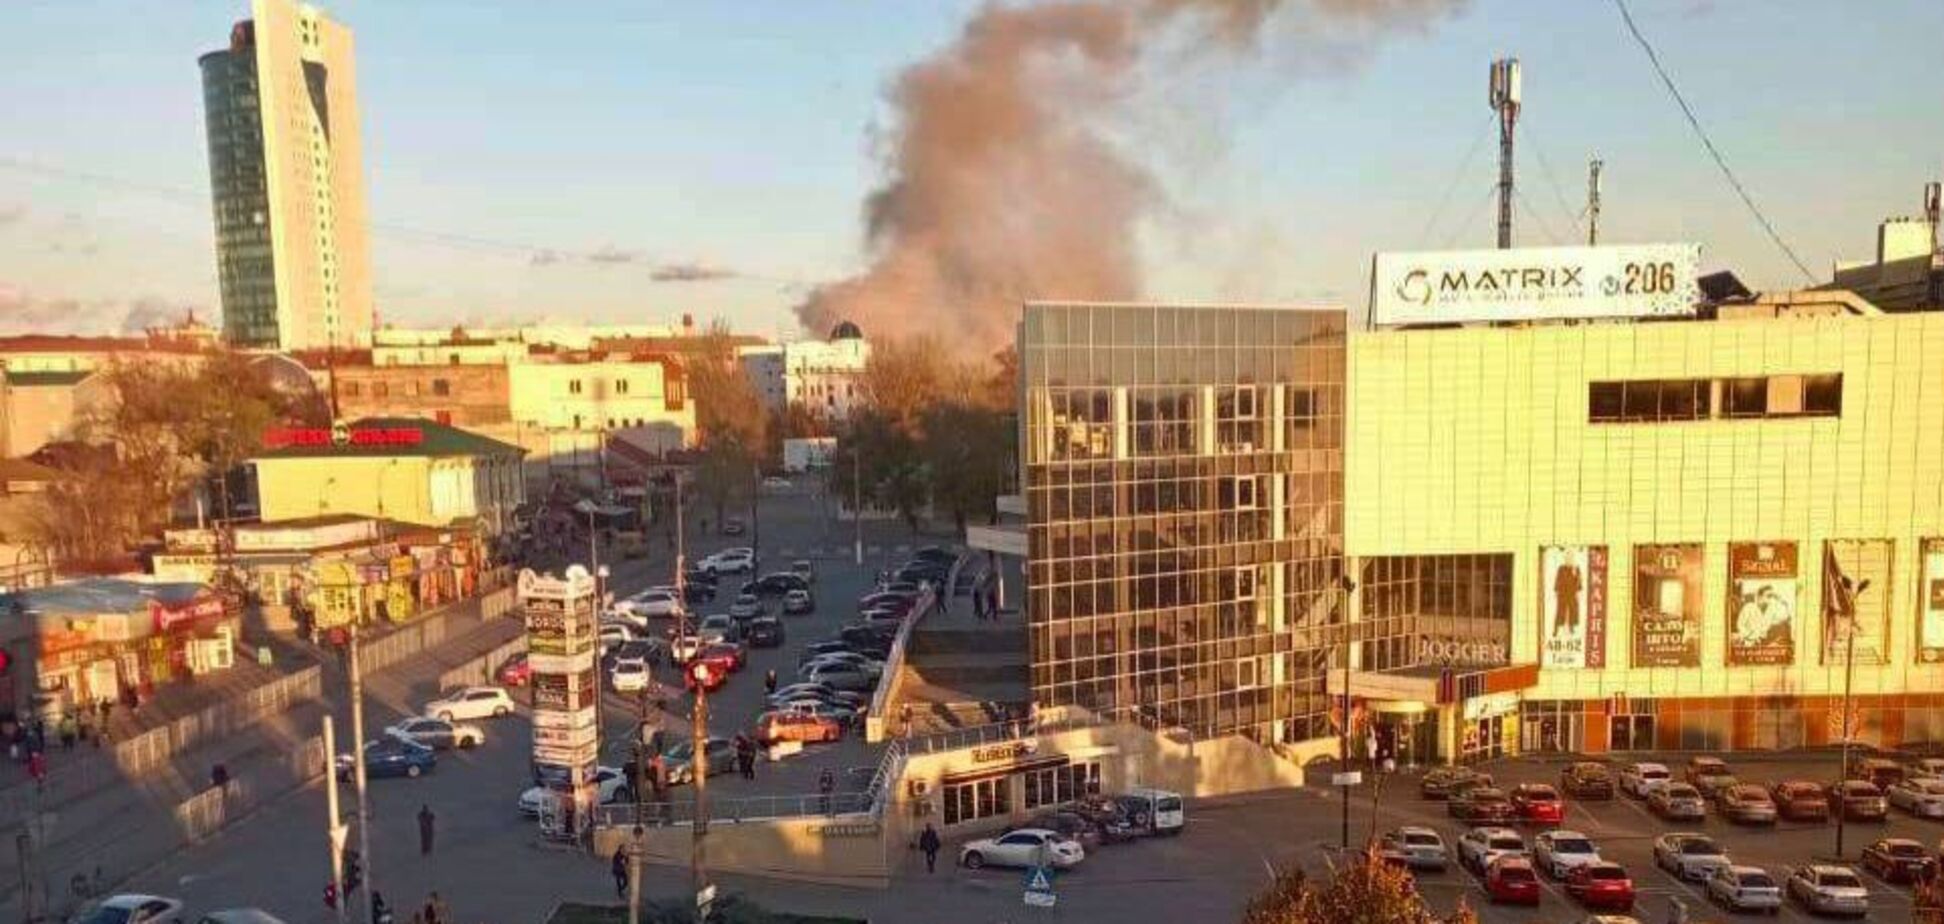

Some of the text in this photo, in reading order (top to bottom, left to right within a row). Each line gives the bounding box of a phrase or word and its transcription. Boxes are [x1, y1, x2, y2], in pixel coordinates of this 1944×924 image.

[1440, 262, 1675, 294] MATRIX 206
[1420, 639, 1506, 662] JOGGER
